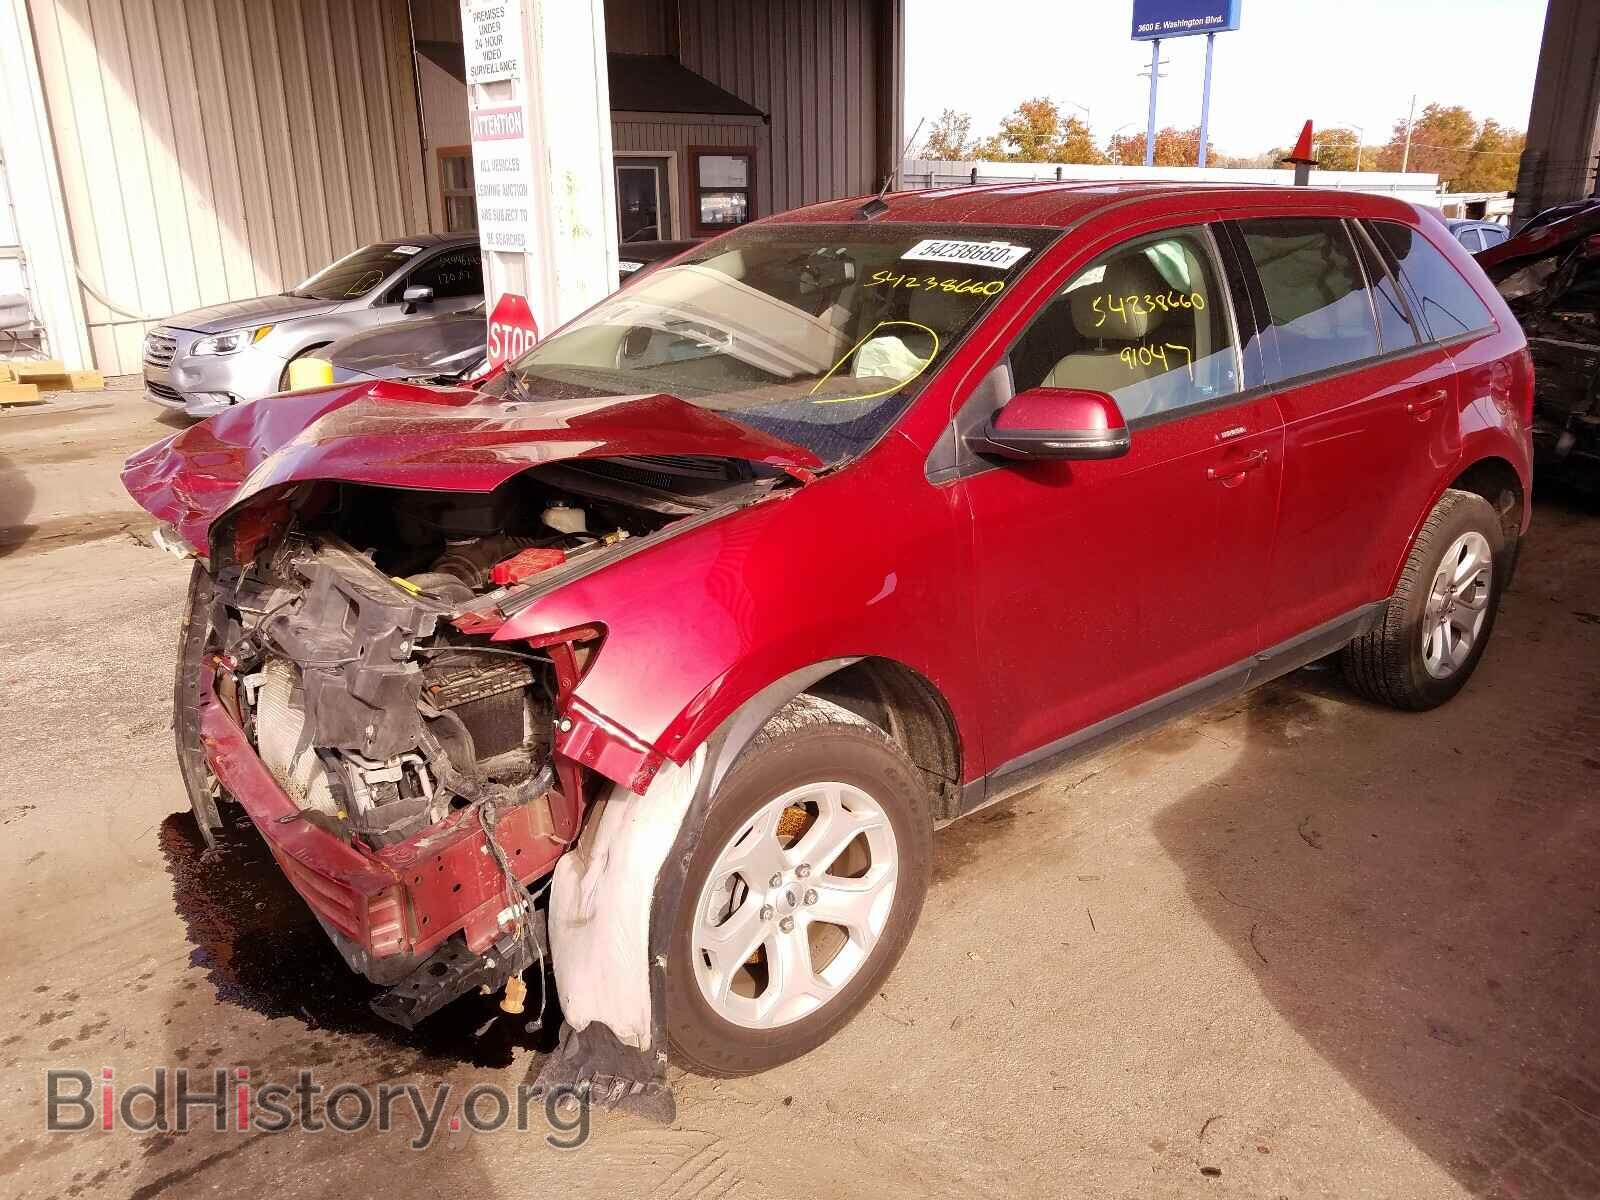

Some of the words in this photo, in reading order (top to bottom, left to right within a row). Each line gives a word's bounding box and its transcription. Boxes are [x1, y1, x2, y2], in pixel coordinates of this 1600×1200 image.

[473, 7, 505, 23] PREMISES
[479, 22, 501, 35] UNDER
[1138, 23, 1154, 32] 3600
[1155, 22, 1162, 31] E.
[1163, 17, 1204, 29] Washington
[1205, 15, 1224, 24] Blvd.
[475, 39, 483, 49] 24
[484, 35, 503, 48] HOUR
[482, 49, 502, 61] VIDEO
[471, 59, 517, 77] SURVEILLANCE
[473, 111, 523, 137] ATTENTION
[480, 159, 491, 172] ALL
[492, 158, 520, 172] VEHICLES
[477, 184, 501, 197] LEAVING
[502, 184, 528, 197] AUCTION
[481, 209, 492, 221] ARE
[493, 208, 518, 222] SUBJECT
[519, 209, 528, 222] TO
[486, 232, 494, 245] BE
[495, 232, 525, 247] SEARCHED
[864, 270, 1005, 296] 54238660
[1092, 291, 1206, 327] 54238660
[490, 323, 537, 360] STOP
[1120, 342, 1195, 383] 91047
